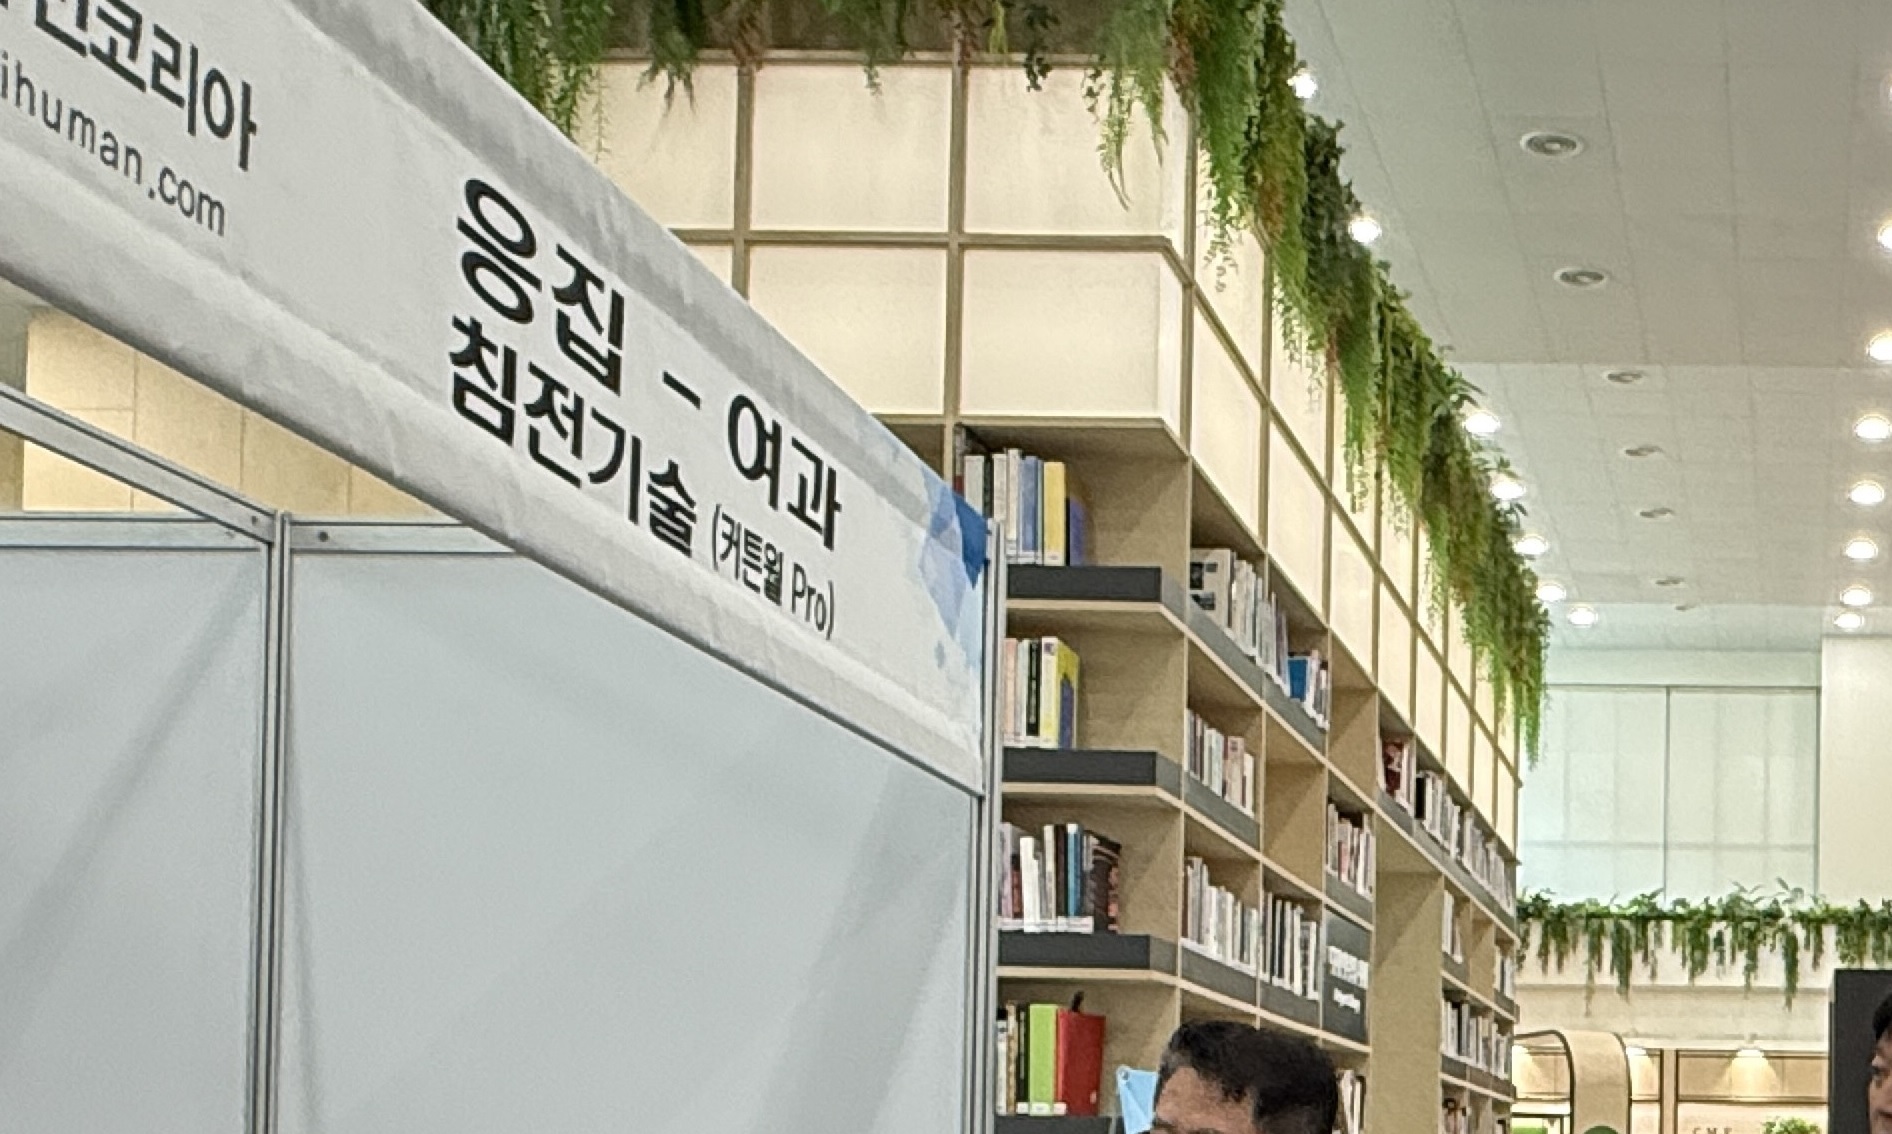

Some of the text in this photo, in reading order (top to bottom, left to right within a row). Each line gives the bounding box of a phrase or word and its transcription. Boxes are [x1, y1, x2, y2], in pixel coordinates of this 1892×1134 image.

[448, 315, 835, 640] 침전기술 (커튼월 Pro)
[457, 178, 625, 397] 응집
[727, 394, 842, 551] 여과
